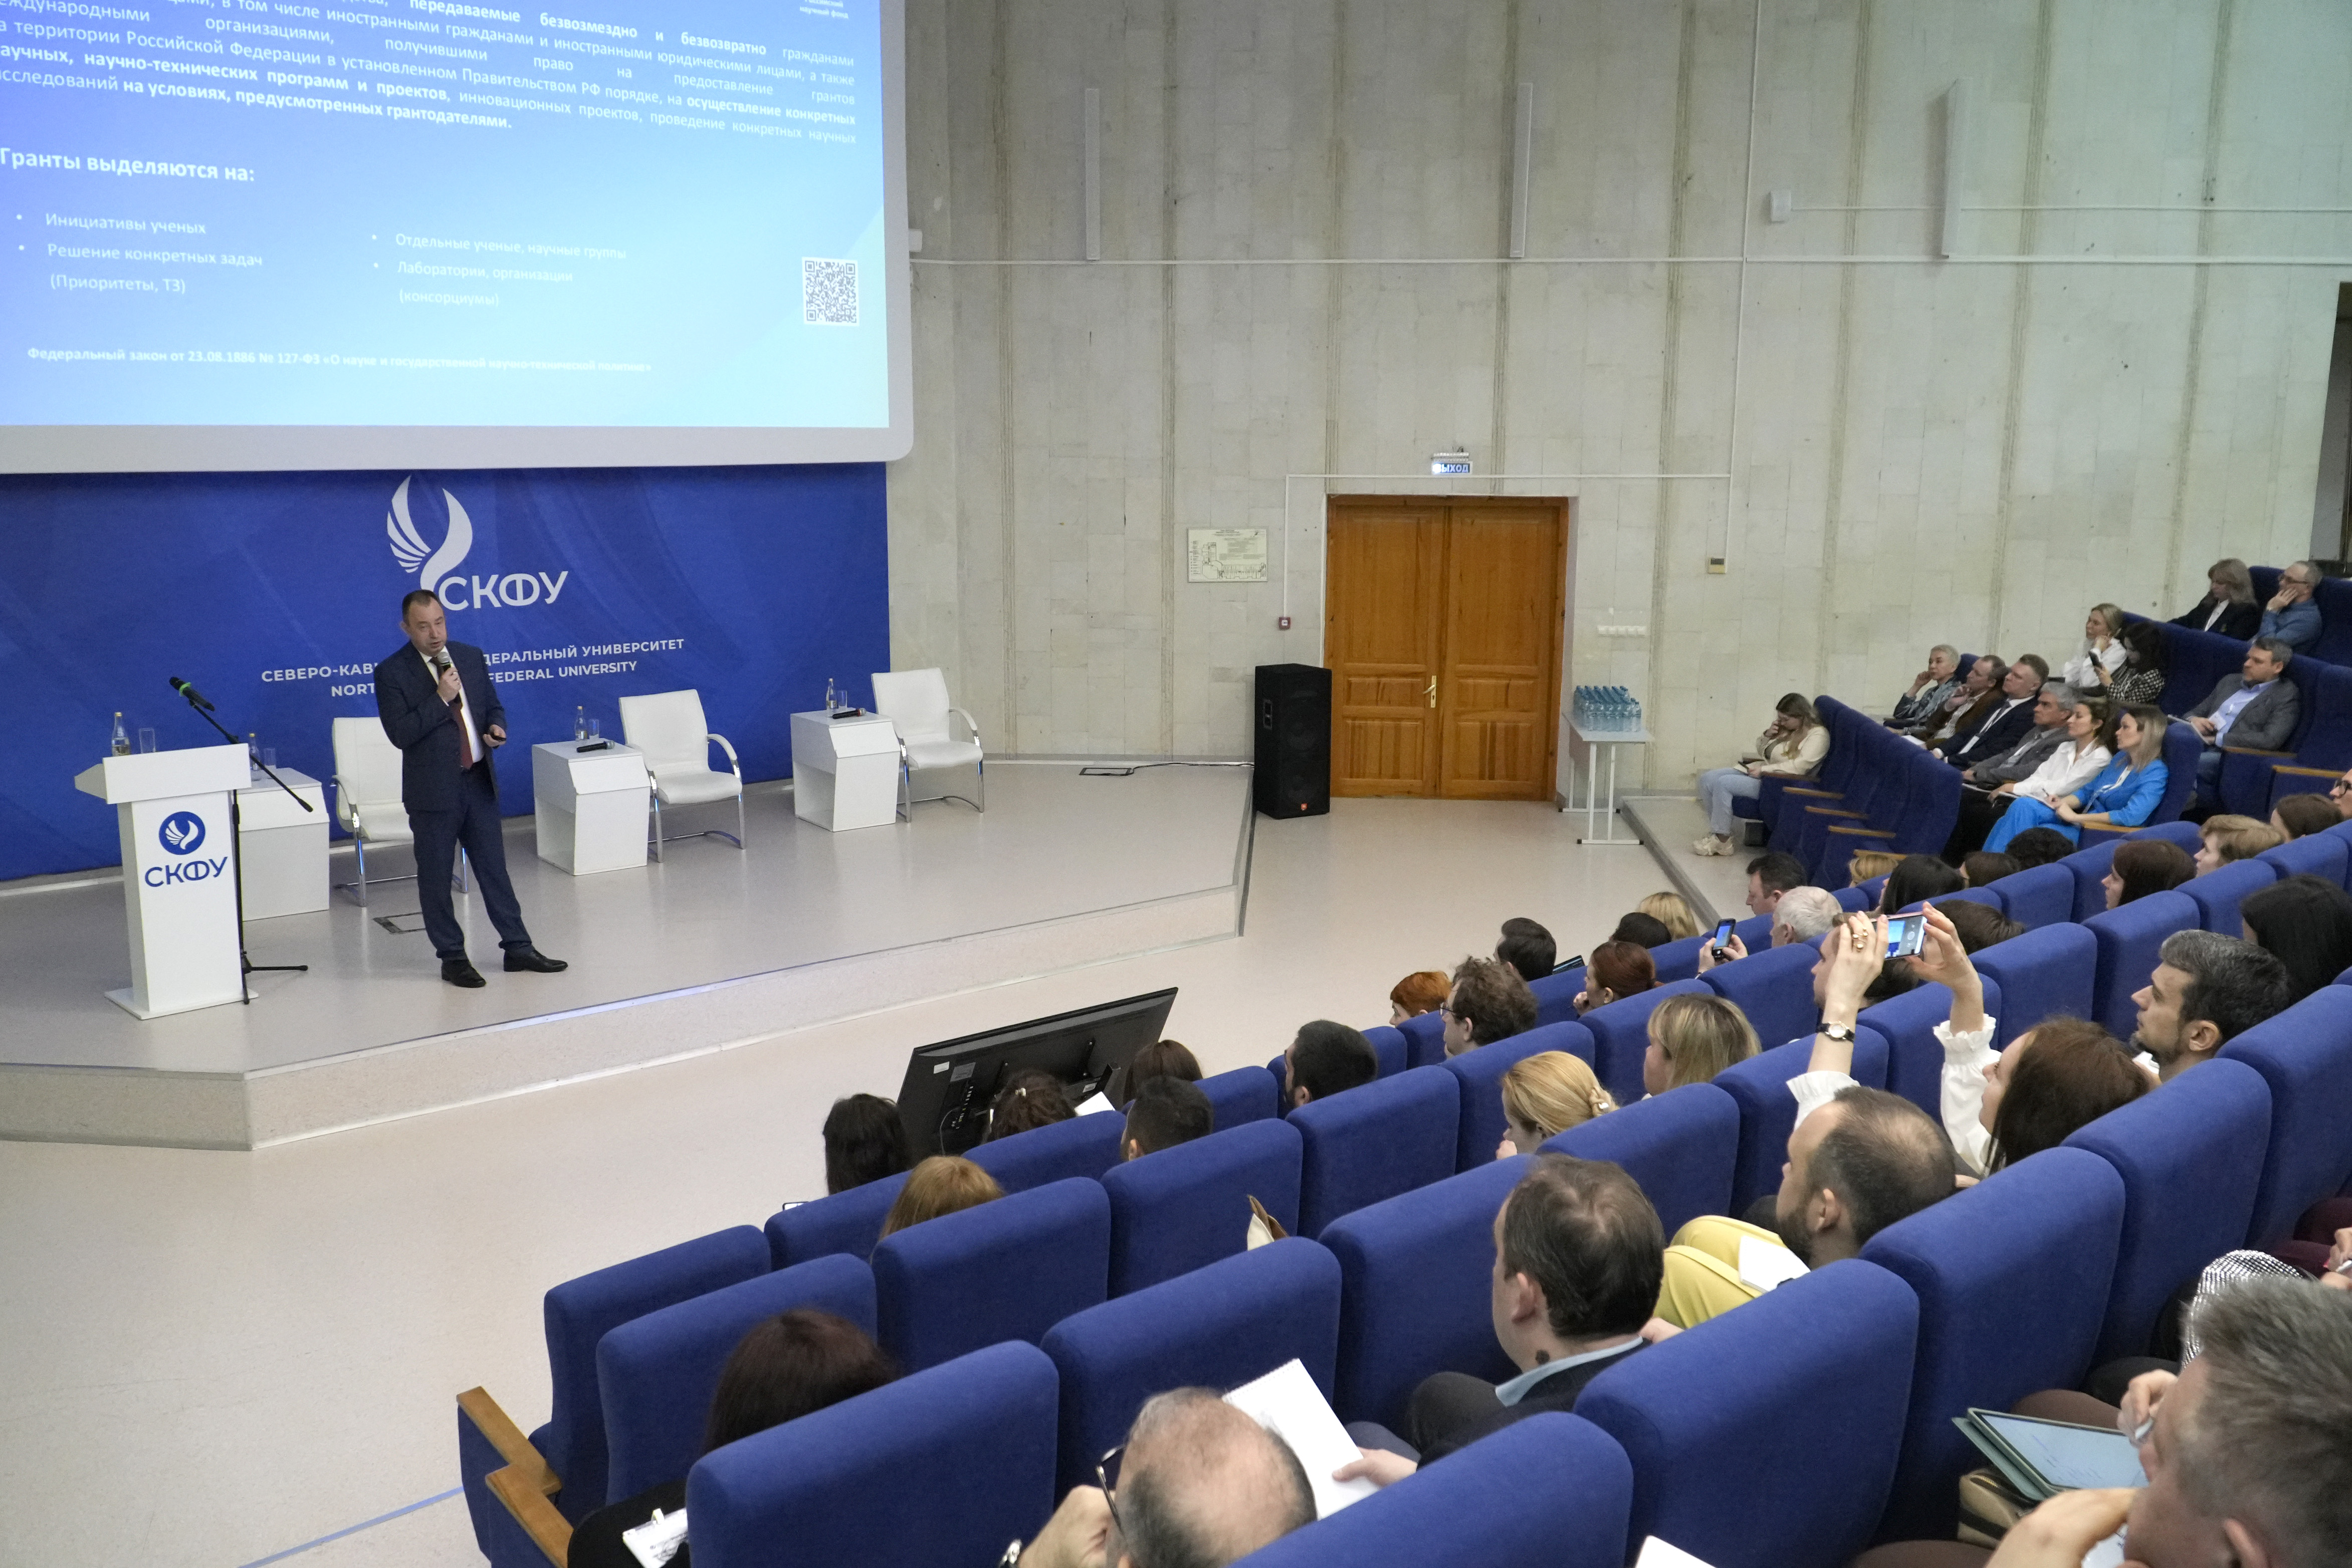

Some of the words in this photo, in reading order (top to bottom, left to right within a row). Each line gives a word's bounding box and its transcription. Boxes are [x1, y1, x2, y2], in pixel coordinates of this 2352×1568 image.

[238, 0, 267, 12] том
[275, 4, 319, 18] числе
[327, 10, 439, 33] иностранными
[447, 25, 533, 45] гражданами
[540, 38, 548, 47] и
[554, 39, 652, 60] иностранными
[658, 53, 751, 72] юридическими
[757, 65, 804, 81] лицами,
[810, 72, 816, 81] а
[821, 74, 854, 86] также
[410, 0, 520, 22] передаваемые
[540, 13, 637, 38] безвозмездно
[656, 32, 663, 41] и
[681, 32, 766, 55] безвозвратно
[783, 49, 853, 66] гражданами
[14, 22, 119, 44] территории
[127, 31, 223, 54] Российской
[230, 42, 320, 65] Федерации
[328, 56, 336, 66] в
[342, 57, 457, 79] установленном
[463, 68, 576, 93] Правительством
[582, 82, 600, 95] РФ
[605, 88, 662, 104] порядке,
[668, 95, 682, 105] на
[687, 97, 781, 116] осуществление
[786, 109, 855, 124] конкретных
[205, 19, 333, 45] организациями,
[385, 40, 487, 60] получившими
[534, 58, 573, 71] право
[617, 68, 632, 78] на
[674, 75, 773, 95] предоставление
[812, 92, 854, 105] грантов
[85, 54, 258, 80] научно-технических
[268, 72, 348, 89] программ
[358, 82, 367, 91] и
[377, 83, 450, 102] проектов,
[460, 93, 571, 114] инновационных
[579, 106, 642, 122] проектов,
[651, 113, 725, 129] проведение
[733, 123, 801, 137] конкретных
[809, 131, 856, 143] научных
[124, 81, 143, 92] на
[148, 83, 231, 103] условиях,
[236, 91, 382, 115] предусмотренных
[387, 106, 511, 128] грантодателями.
[0, 148, 80, 169] Гранты
[88, 158, 218, 178] выделяются
[225, 168, 254, 181] на:
[46, 213, 145, 230] Инициативы
[151, 222, 205, 234] ученых
[48, 244, 120, 259] Решение
[125, 250, 216, 264] конкретных
[222, 255, 262, 267] задач
[396, 234, 470, 249] Отдельные
[474, 242, 524, 253] ученые,
[528, 245, 580, 256] научные
[584, 248, 626, 259] группы
[51, 274, 158, 292] (Приоритеты,
[163, 279, 185, 294] ТЗ)
[398, 261, 489, 278] Лаборатории,
[493, 269, 573, 282] организации
[399, 289, 499, 306] (консорциумы)
[28, 348, 125, 362] Федеральный
[130, 352, 167, 361] закон
[170, 353, 184, 361] от
[391, 358, 486, 368] государственной
[489, 361, 595, 370] научно-технической
[439, 571, 569, 611] СКФУ
[261, 662, 378, 682] СЕВЕРО-КАВ
[581, 638, 685, 657] УНИВЕРСИТЕТ
[558, 661, 637, 678] UNIVERSITY
[144, 856, 229, 887] СКФУ
